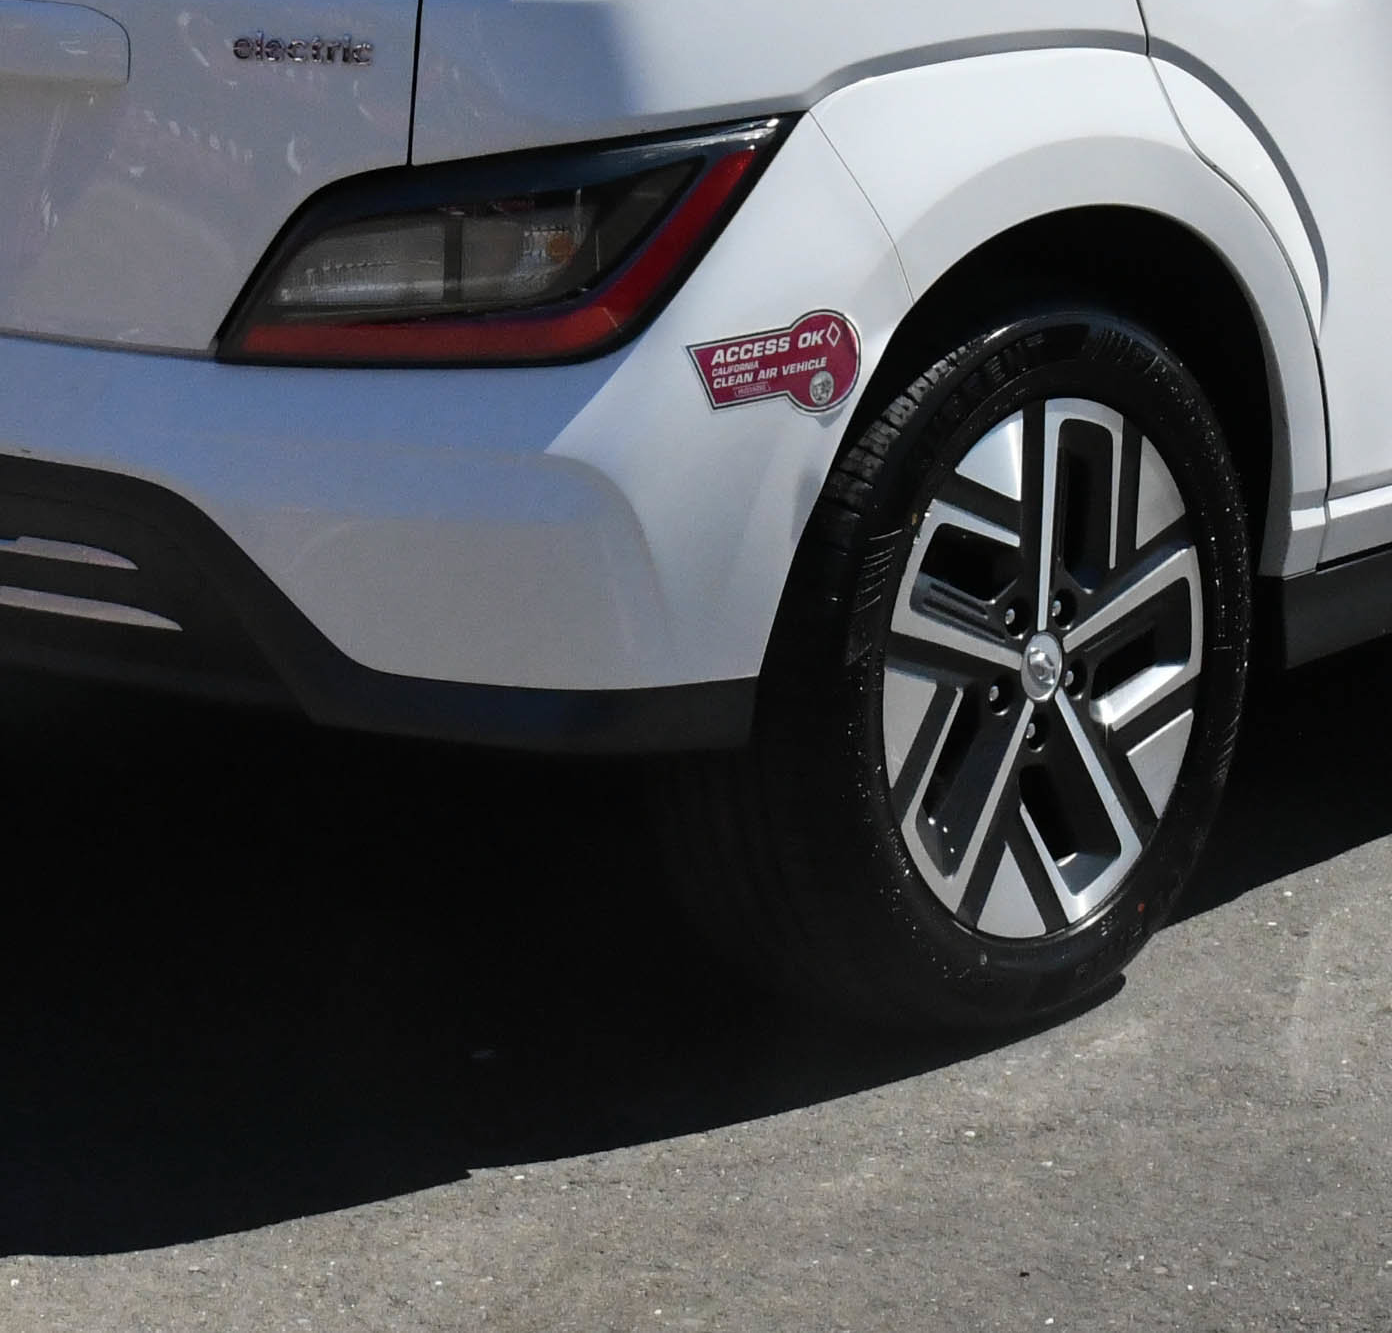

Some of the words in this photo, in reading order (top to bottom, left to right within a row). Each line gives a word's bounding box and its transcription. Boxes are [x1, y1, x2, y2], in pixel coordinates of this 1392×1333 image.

[233, 30, 373, 65] electric
[711, 337, 790, 365] ACCESS
[798, 329, 825, 349] OK
[712, 360, 759, 377] CALIFORNIA
[714, 372, 753, 389] CLEAN
[758, 368, 777, 381] AIR
[782, 357, 827, 376] VEHICLE
